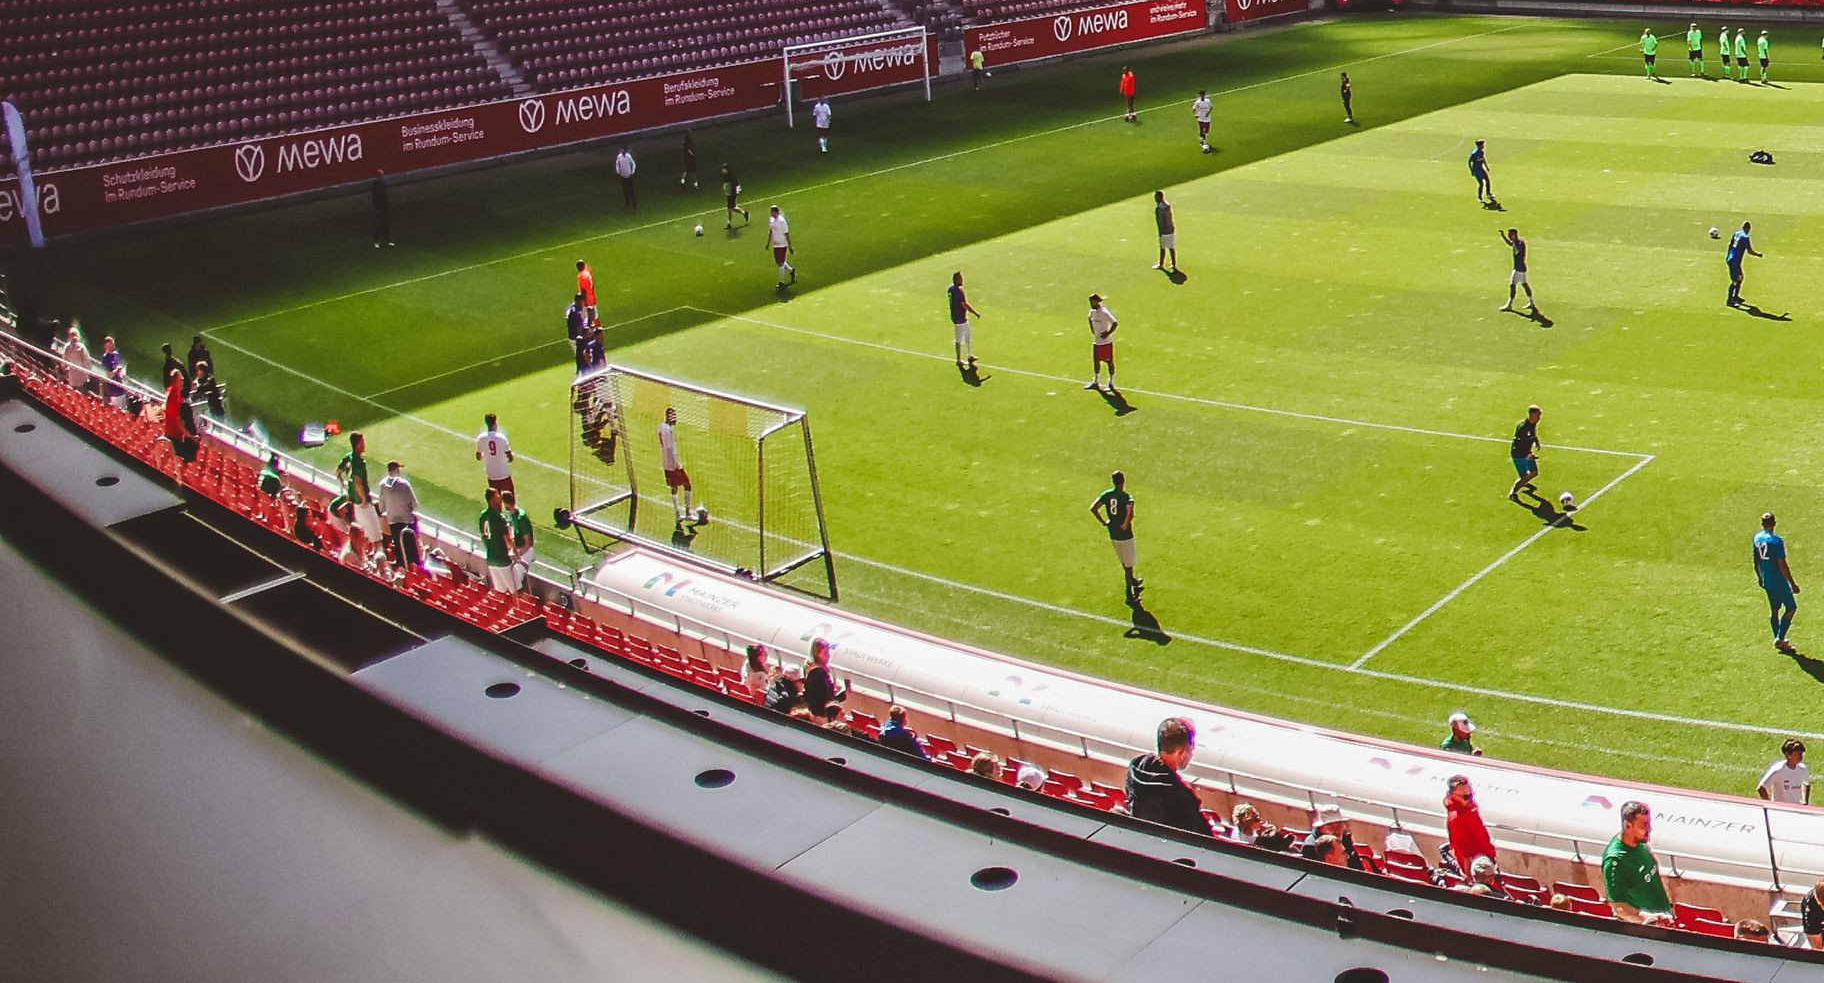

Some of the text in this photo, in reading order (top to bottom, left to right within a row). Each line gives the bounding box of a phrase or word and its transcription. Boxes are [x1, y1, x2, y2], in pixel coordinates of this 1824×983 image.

[663, 77, 719, 94] Berufskleidung
[401, 117, 475, 137] Businesskleidung
[403, 129, 485, 151] im Rundum-Service
[103, 166, 176, 187] Schutzkleidung
[118, 178, 196, 200] Rundum-Service
[489, 440, 498, 456] 9
[1110, 498, 1118, 516] 8
[1758, 542, 1770, 560] 12
